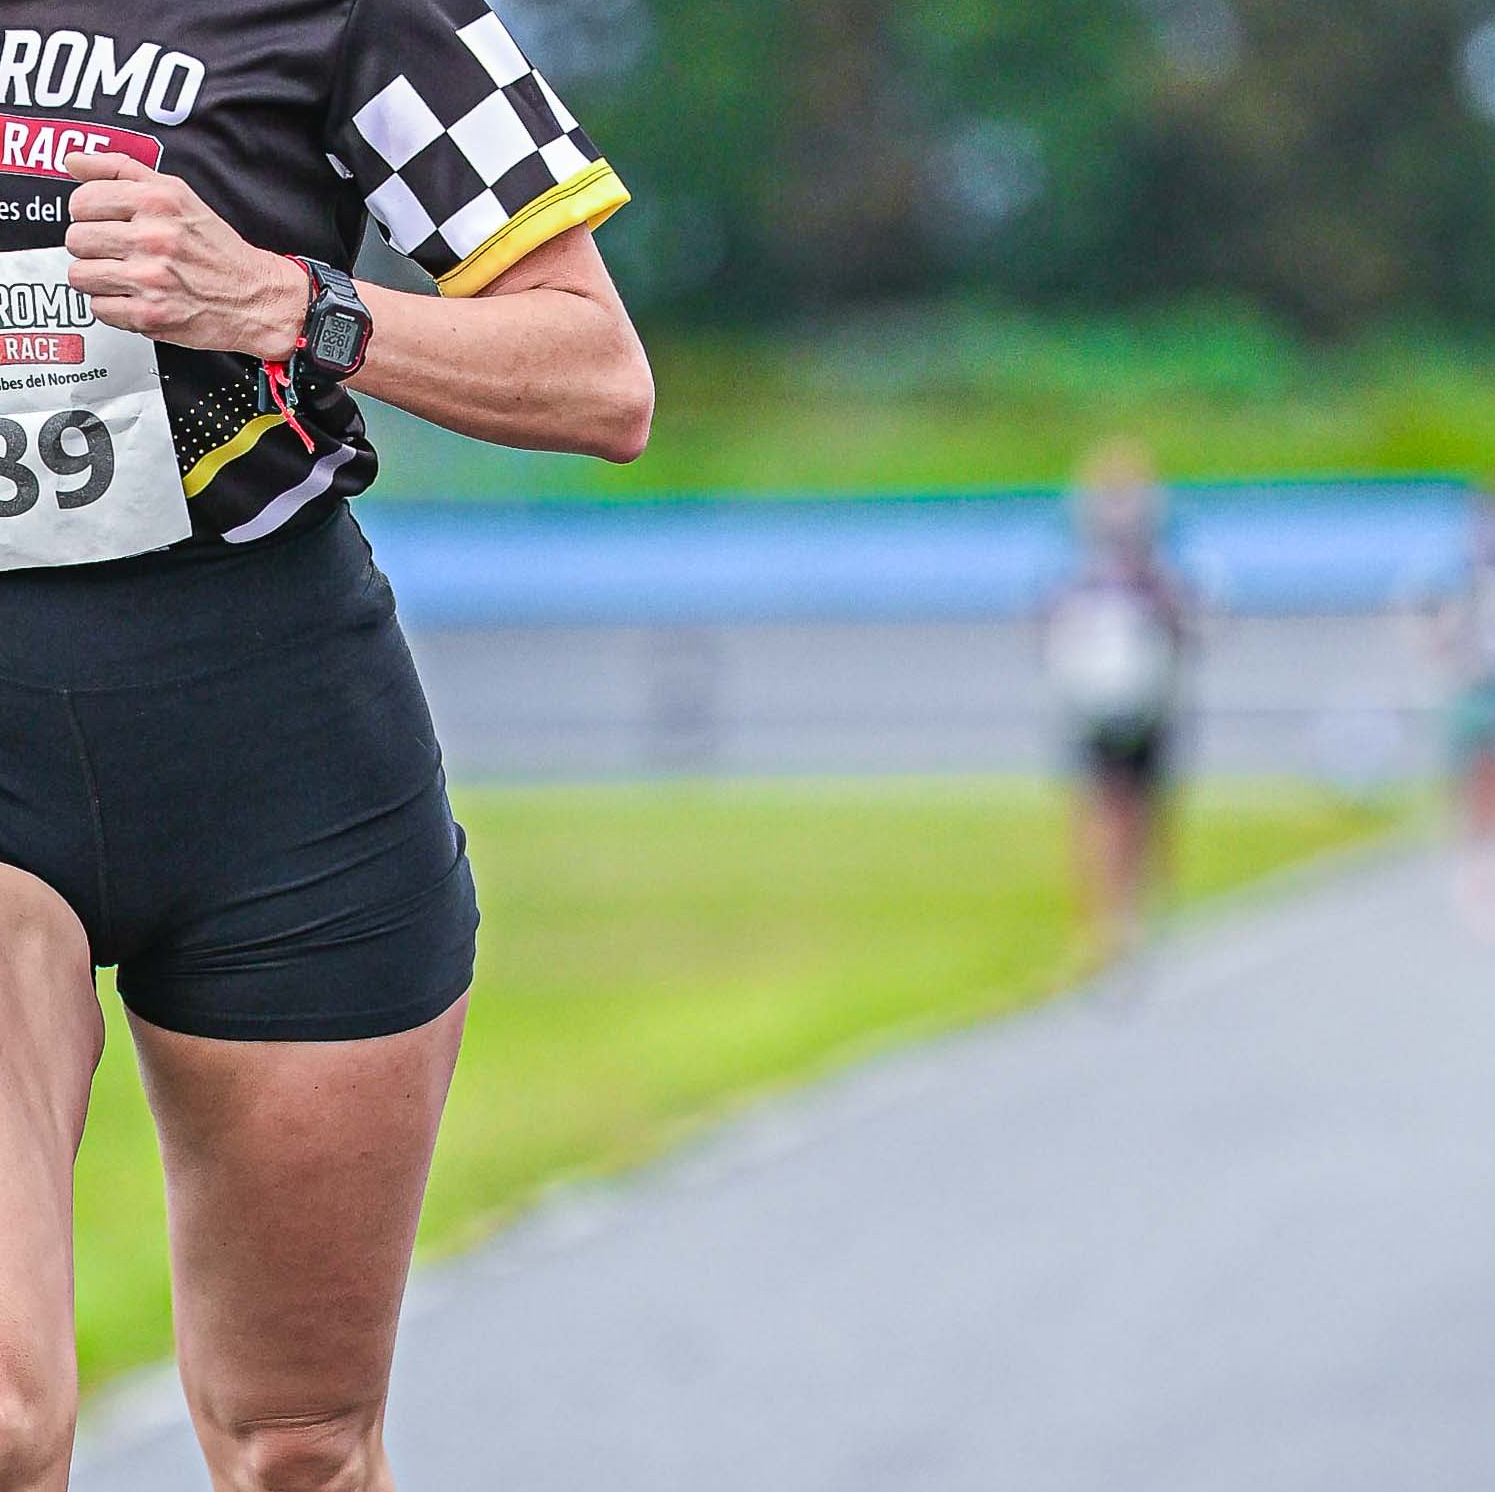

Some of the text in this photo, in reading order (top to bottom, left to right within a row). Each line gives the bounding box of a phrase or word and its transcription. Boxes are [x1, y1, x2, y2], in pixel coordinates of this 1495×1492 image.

[25, 196, 62, 222] del
[6, 336, 60, 362] RACE
[26, 374, 46, 389] del
[48, 368, 108, 386] Noroeste
